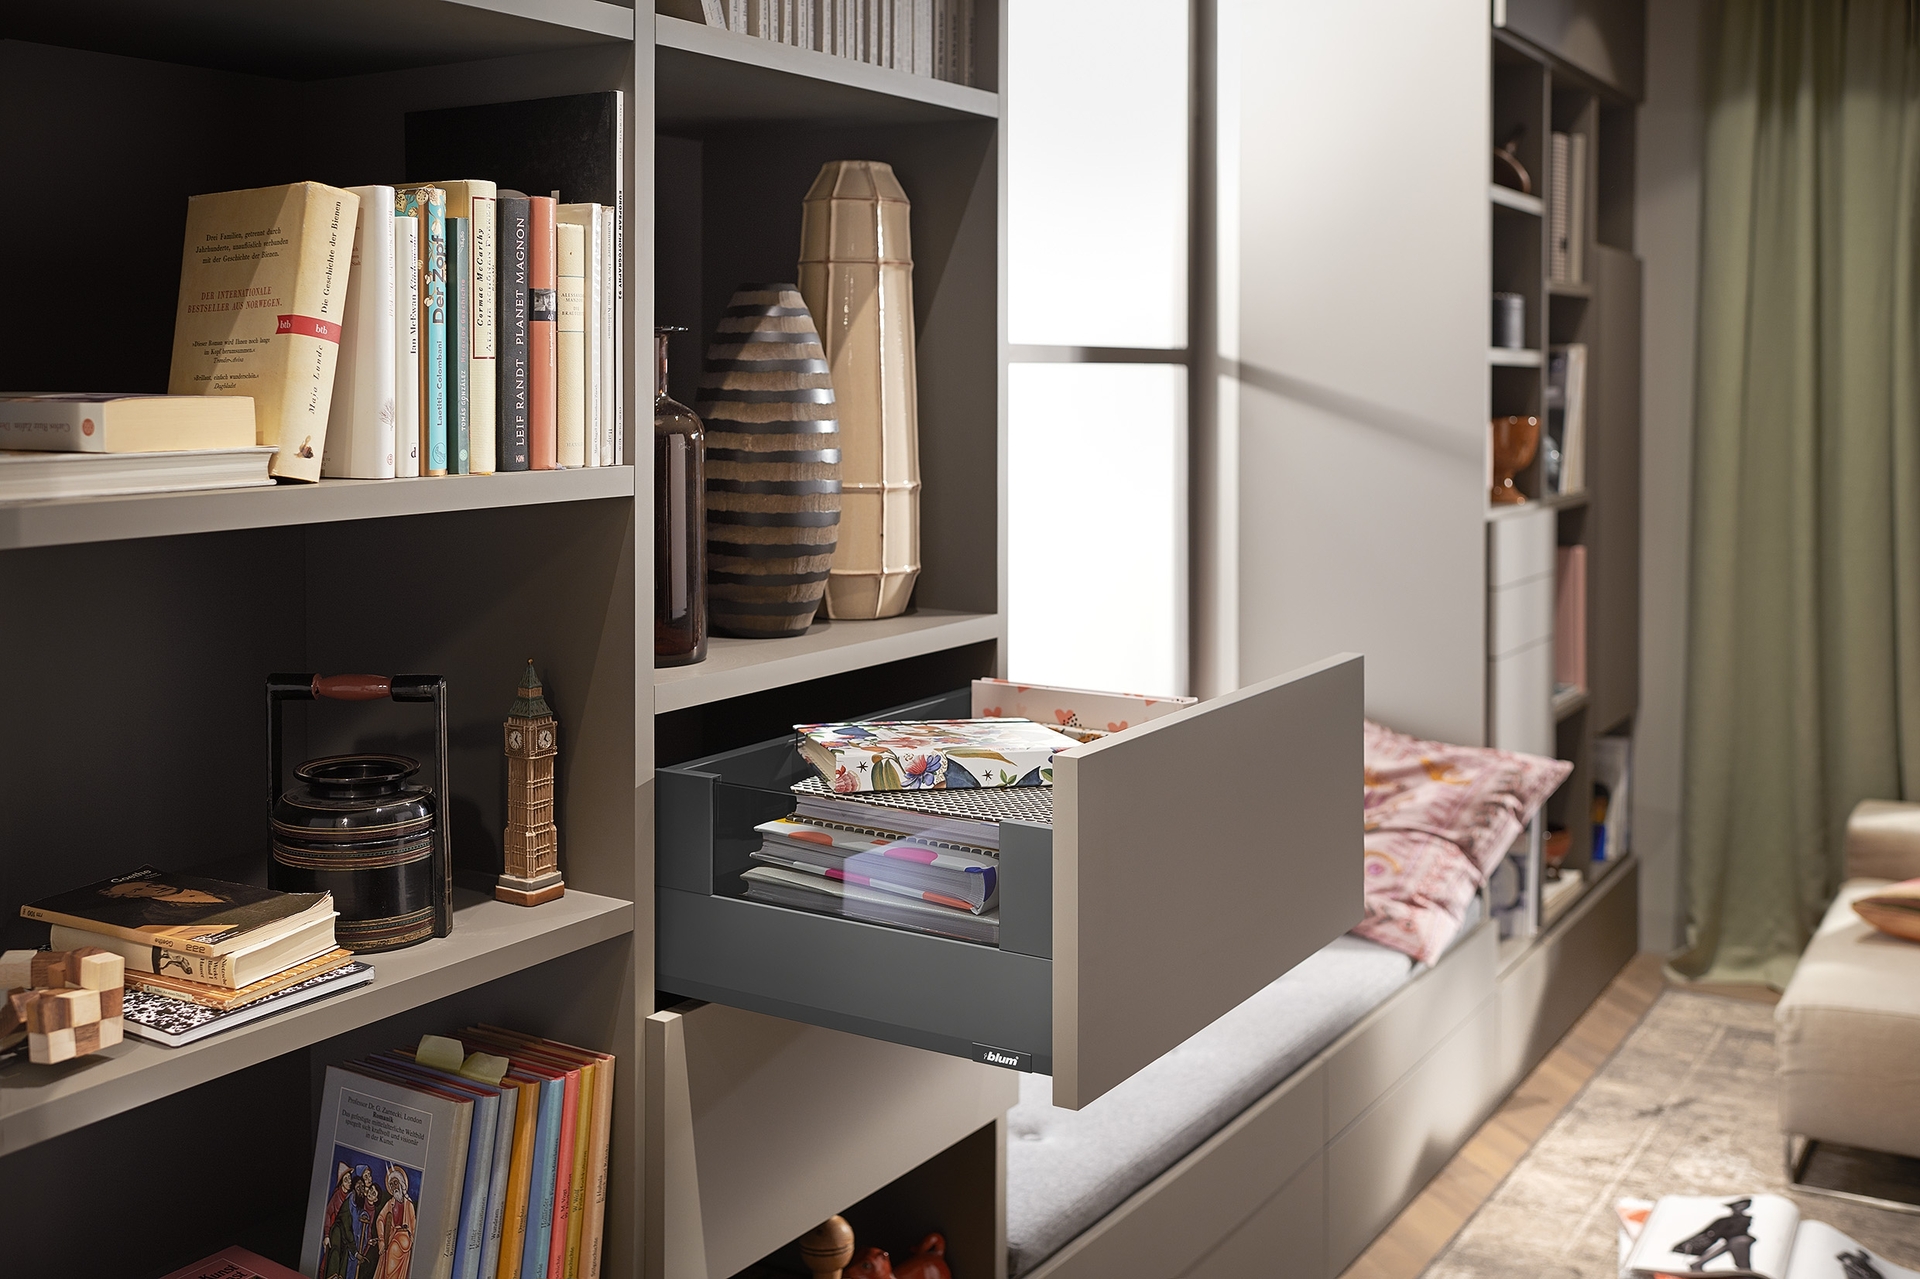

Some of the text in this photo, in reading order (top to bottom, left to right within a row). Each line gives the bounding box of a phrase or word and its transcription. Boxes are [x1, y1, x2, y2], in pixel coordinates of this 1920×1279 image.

[220, 232, 243, 240] Familien,
[245, 230, 265, 239] getrennt
[266, 227, 282, 236] durch
[196, 245, 231, 253] Jahrhunderte,
[264, 238, 288, 247] verbunden
[323, 249, 335, 296] Geschichte
[331, 201, 341, 230] Bienen
[516, 218, 524, 284] MAGNON
[223, 253, 250, 262] Geschichte
[432, 234, 446, 324] Der Zopf
[201, 286, 272, 301] DER INTERNATIONALE
[188, 298, 282, 314] BESTSELLER AUS NORWEGEN.
[280, 320, 291, 328] btb
[516, 290, 524, 345] PLANET
[315, 324, 328, 334] btb
[308, 345, 324, 415] Maja Lunde
[460, 370, 469, 405] GONZÁLEZ
[516, 359, 524, 409] RANDT
[516, 416, 524, 446] LEIF
[111, 870, 151, 882] Goethe
[155, 938, 173, 947] Goethe
[986, 1051, 1018, 1066] blum
[348, 1096, 368, 1108] Professor
[404, 1114, 422, 1124] London
[372, 1111, 394, 1123] Romanik
[342, 1109, 350, 1117] Das
[372, 1120, 404, 1134] mittelalterliche
[405, 1129, 424, 1140] Weltbild
[346, 1119, 361, 1129] spiegelt
[372, 1126, 390, 1138] kraftvoll
[391, 1132, 400, 1140] und
[491, 1208, 499, 1240] Wundram
[443, 1230, 452, 1257] Zarnecki
[469, 1229, 477, 1250] Hutter
